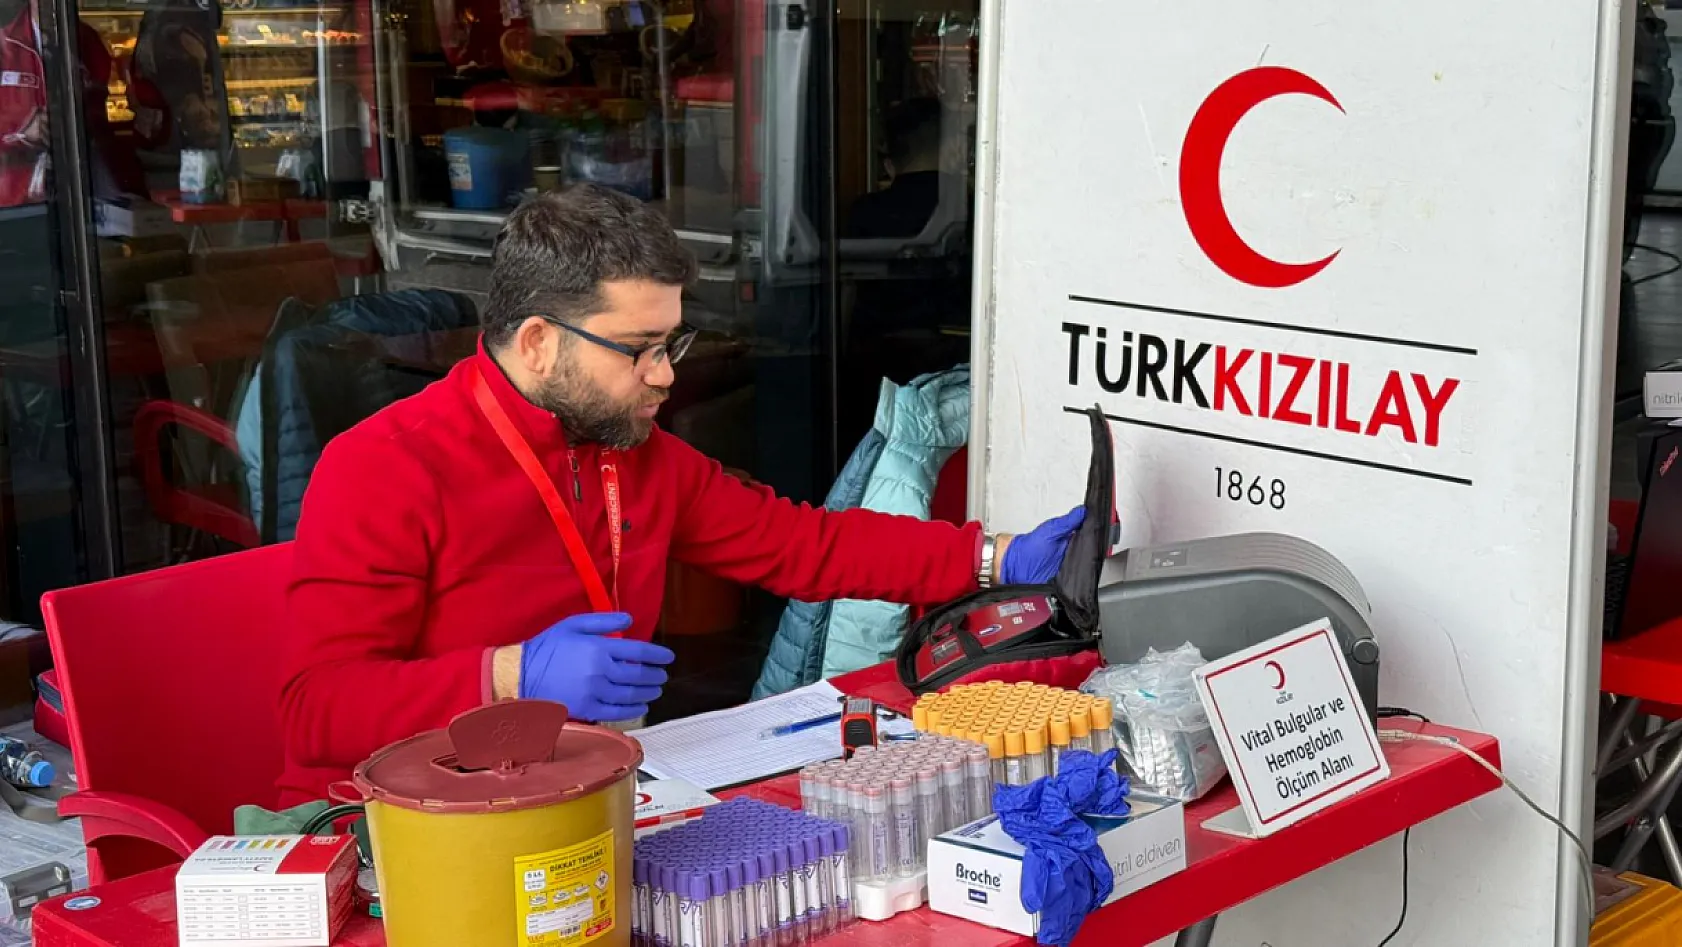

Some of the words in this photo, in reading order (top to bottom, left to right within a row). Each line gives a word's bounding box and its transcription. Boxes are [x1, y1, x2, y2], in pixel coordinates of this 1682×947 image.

[1214, 467, 1286, 509] 1868
[1240, 723, 1275, 751] Vital
[1274, 705, 1327, 738] Bulgular
[1330, 697, 1345, 714] ve
[1265, 727, 1344, 773] Hemoglobin
[1276, 768, 1320, 799] Ölçüm
[1322, 754, 1354, 780] Alanı
[956, 862, 1001, 887] Broche
[1112, 852, 1132, 878] itril
[1136, 838, 1181, 867] eldiven
